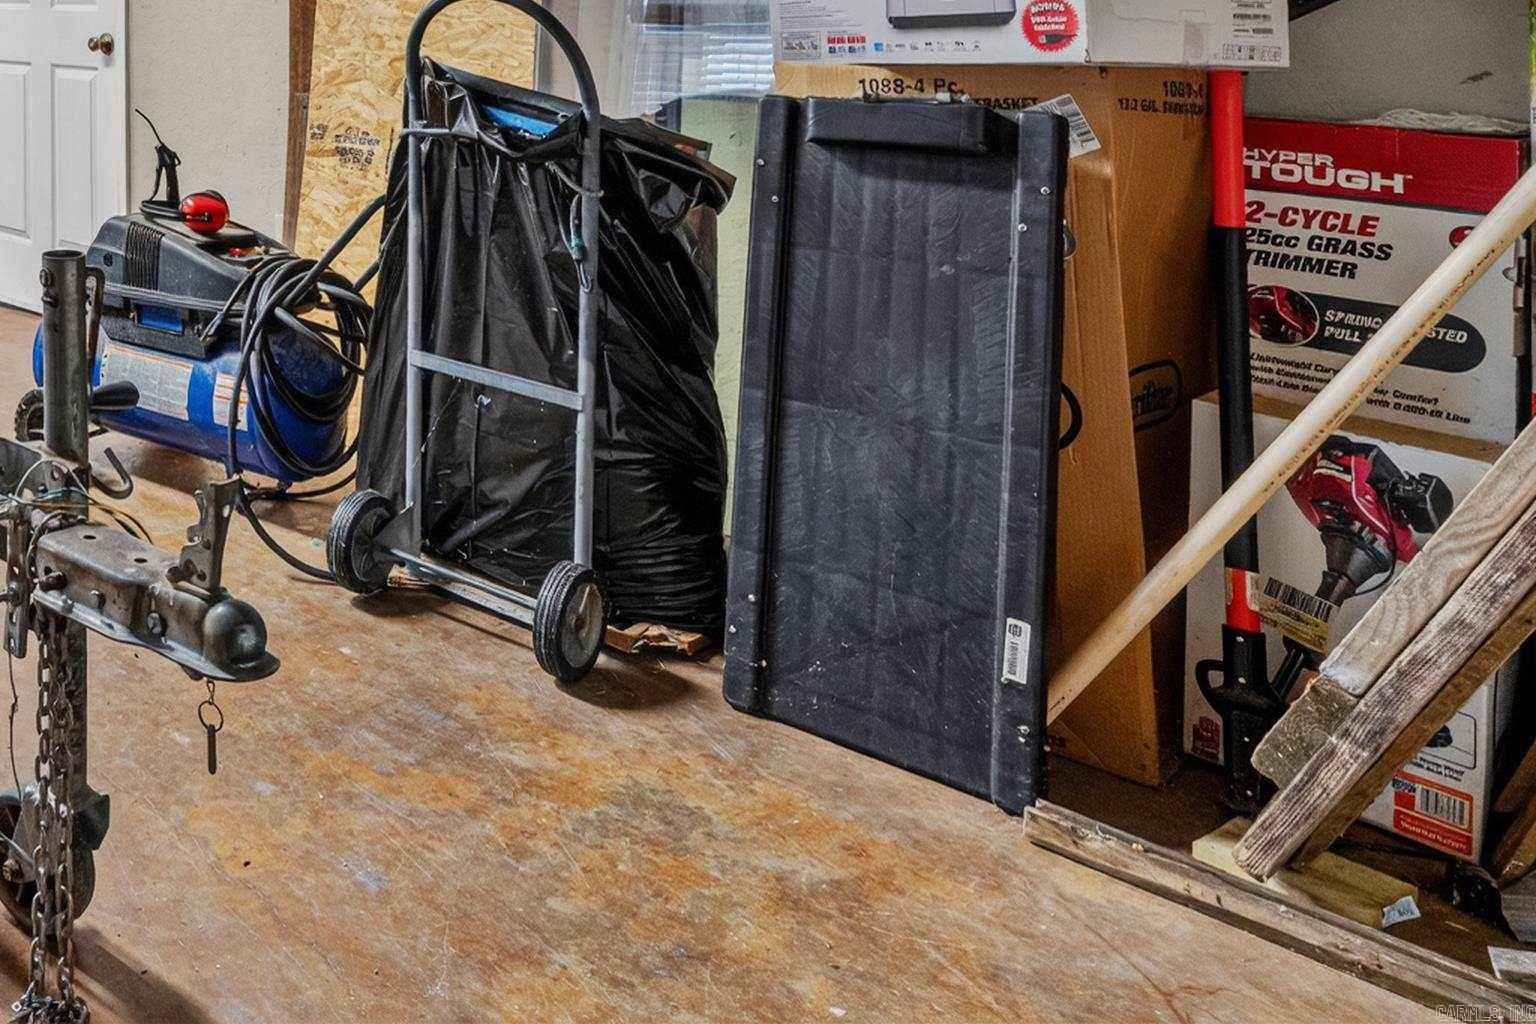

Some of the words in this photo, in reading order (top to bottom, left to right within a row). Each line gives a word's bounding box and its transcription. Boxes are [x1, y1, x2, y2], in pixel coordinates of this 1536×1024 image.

[1242, 148, 1334, 167] HYPER
[1243, 160, 1406, 195] TOUGH
[1245, 201, 1381, 238] 2-CYCLE
[1245, 227, 1300, 248] 25cc
[1307, 235, 1394, 261] GRASS
[1324, 326, 1362, 343] PULL
